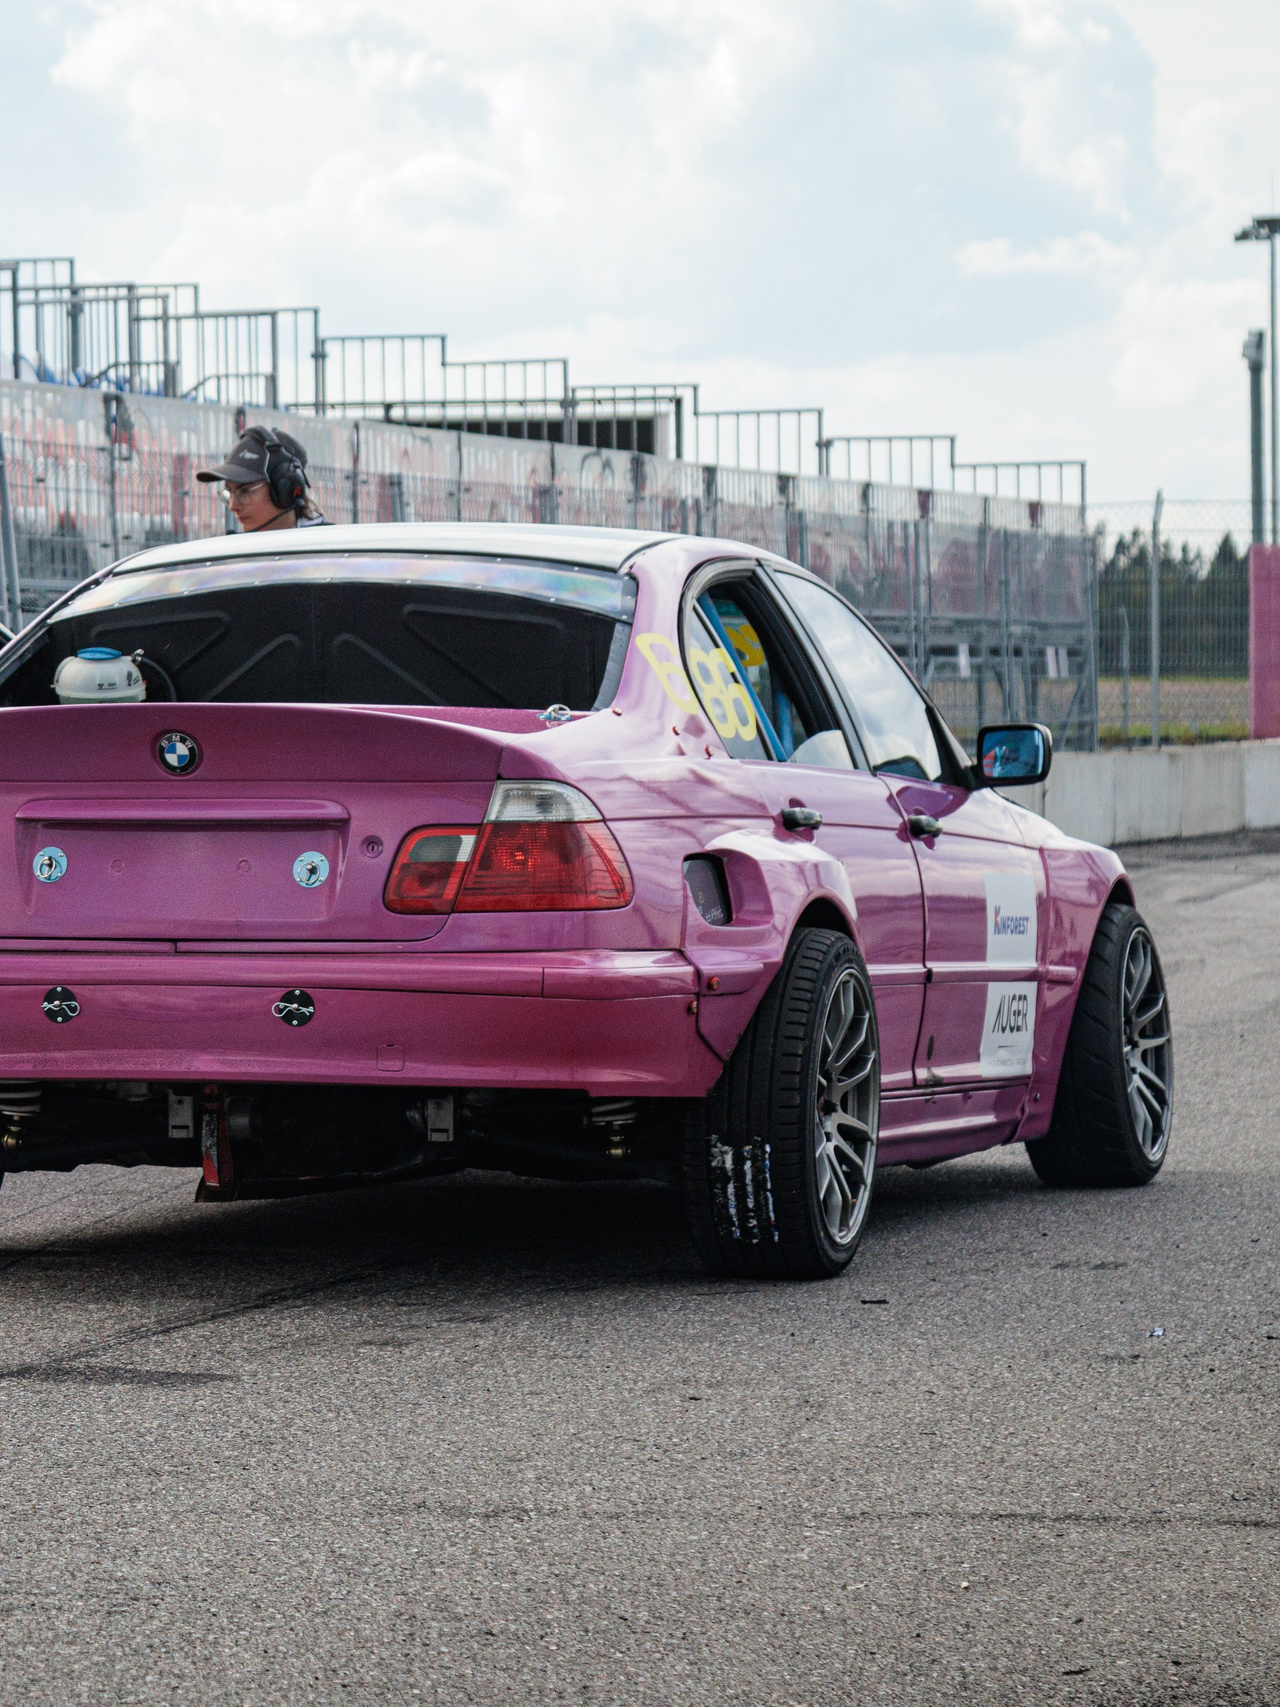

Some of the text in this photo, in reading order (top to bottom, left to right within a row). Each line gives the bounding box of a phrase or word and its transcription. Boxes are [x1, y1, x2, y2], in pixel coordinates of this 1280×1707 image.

[161, 735, 193, 749] BMW
[993, 905, 1029, 935] KINFOREST
[991, 994, 1029, 1034] AUGER
